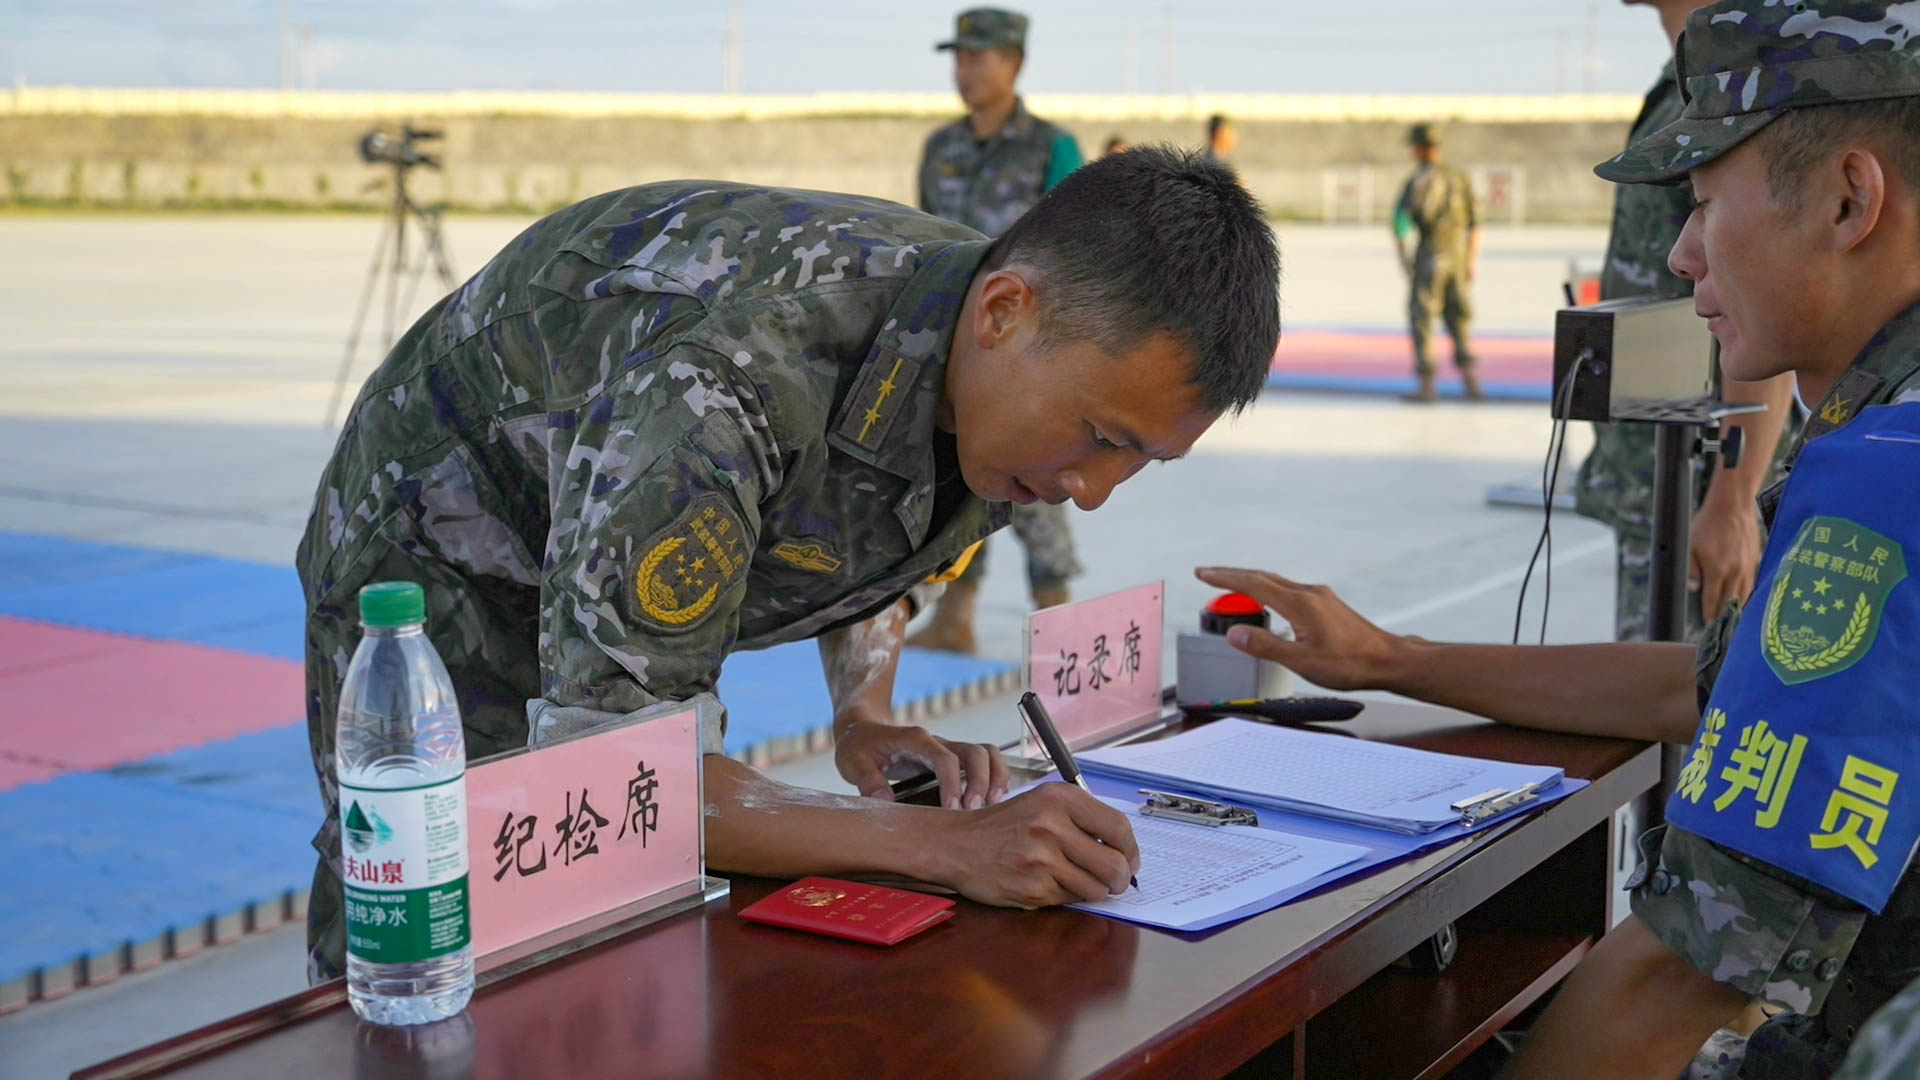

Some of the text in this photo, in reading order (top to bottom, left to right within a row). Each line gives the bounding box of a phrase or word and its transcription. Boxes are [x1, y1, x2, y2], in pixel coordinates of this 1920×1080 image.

[704, 506, 745, 570] 中国人民
[1814, 526, 1889, 566] 国人民
[1053, 619, 1142, 697] 记录席
[493, 760, 659, 882] 纪检席
[342, 855, 404, 884] 夫山泉
